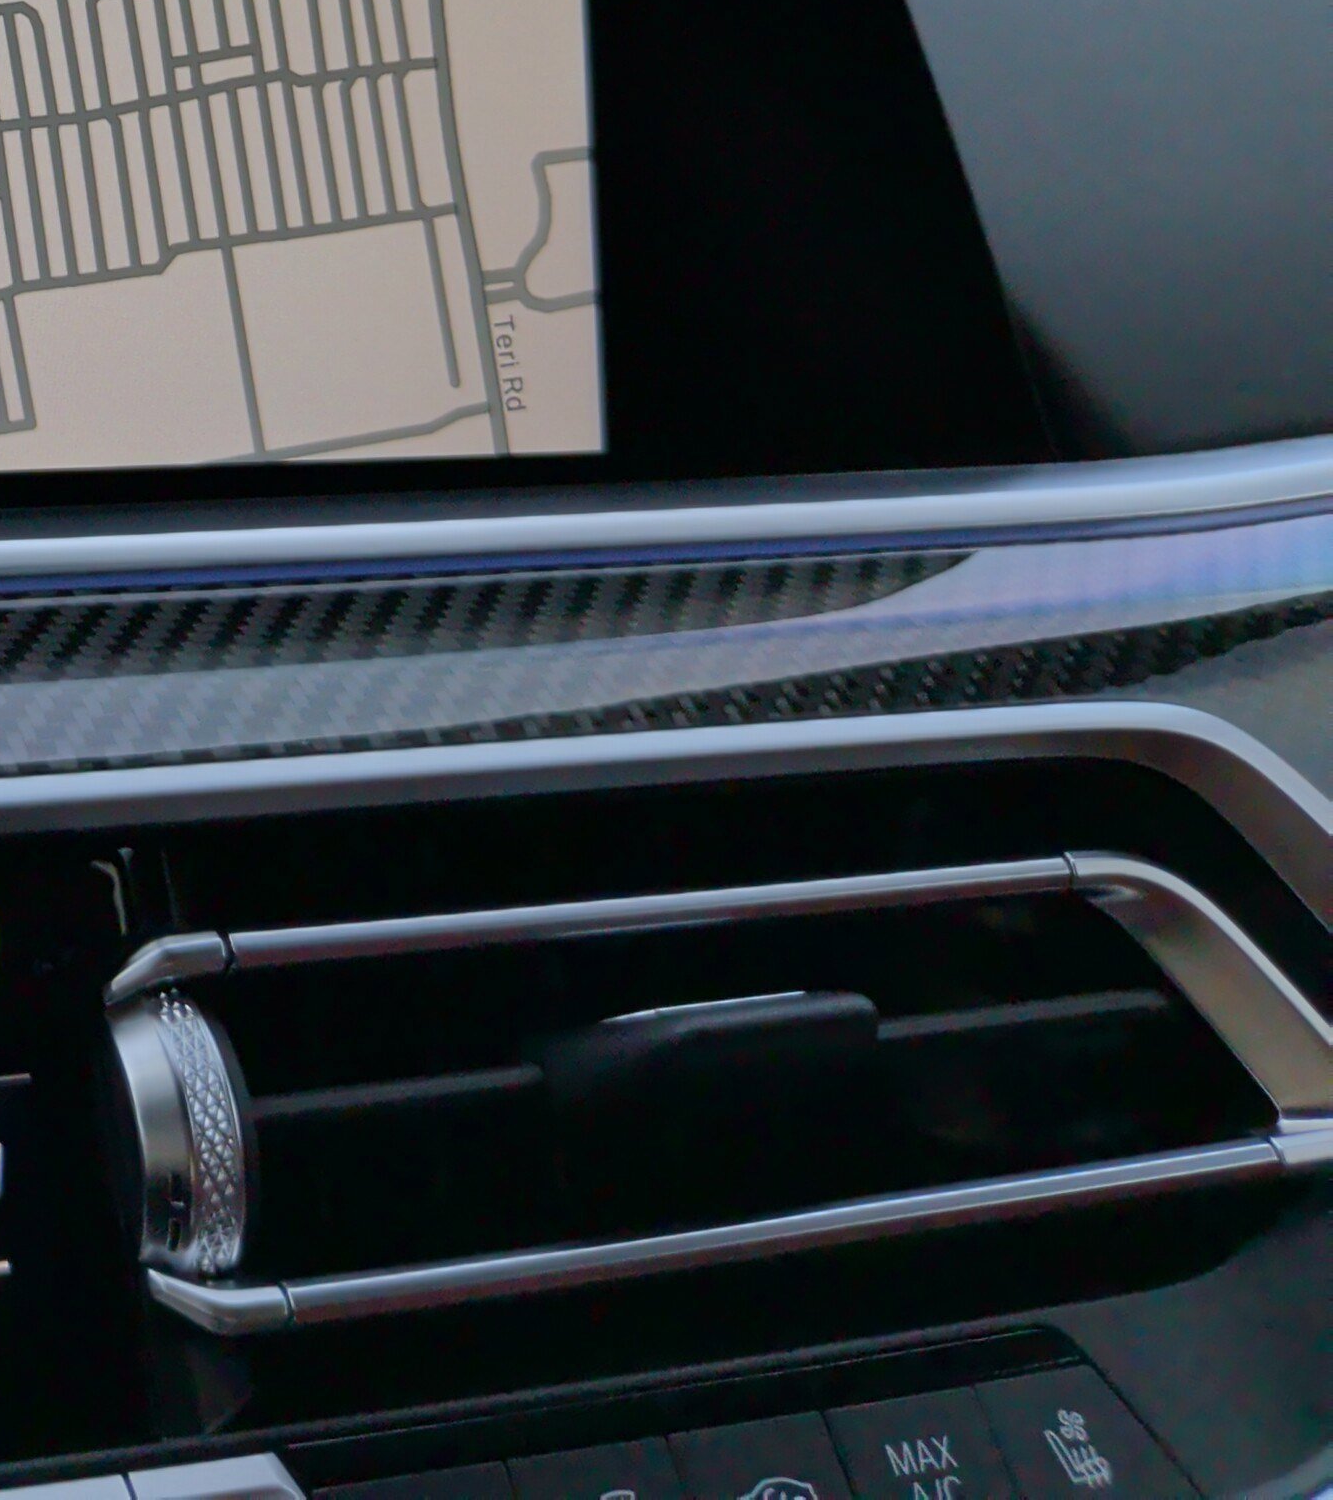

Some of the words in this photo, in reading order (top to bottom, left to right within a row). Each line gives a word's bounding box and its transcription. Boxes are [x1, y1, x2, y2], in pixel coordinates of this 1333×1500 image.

[493, 314, 520, 369] Teri
[502, 376, 527, 412] Rd
[884, 1434, 960, 1478] MAX
